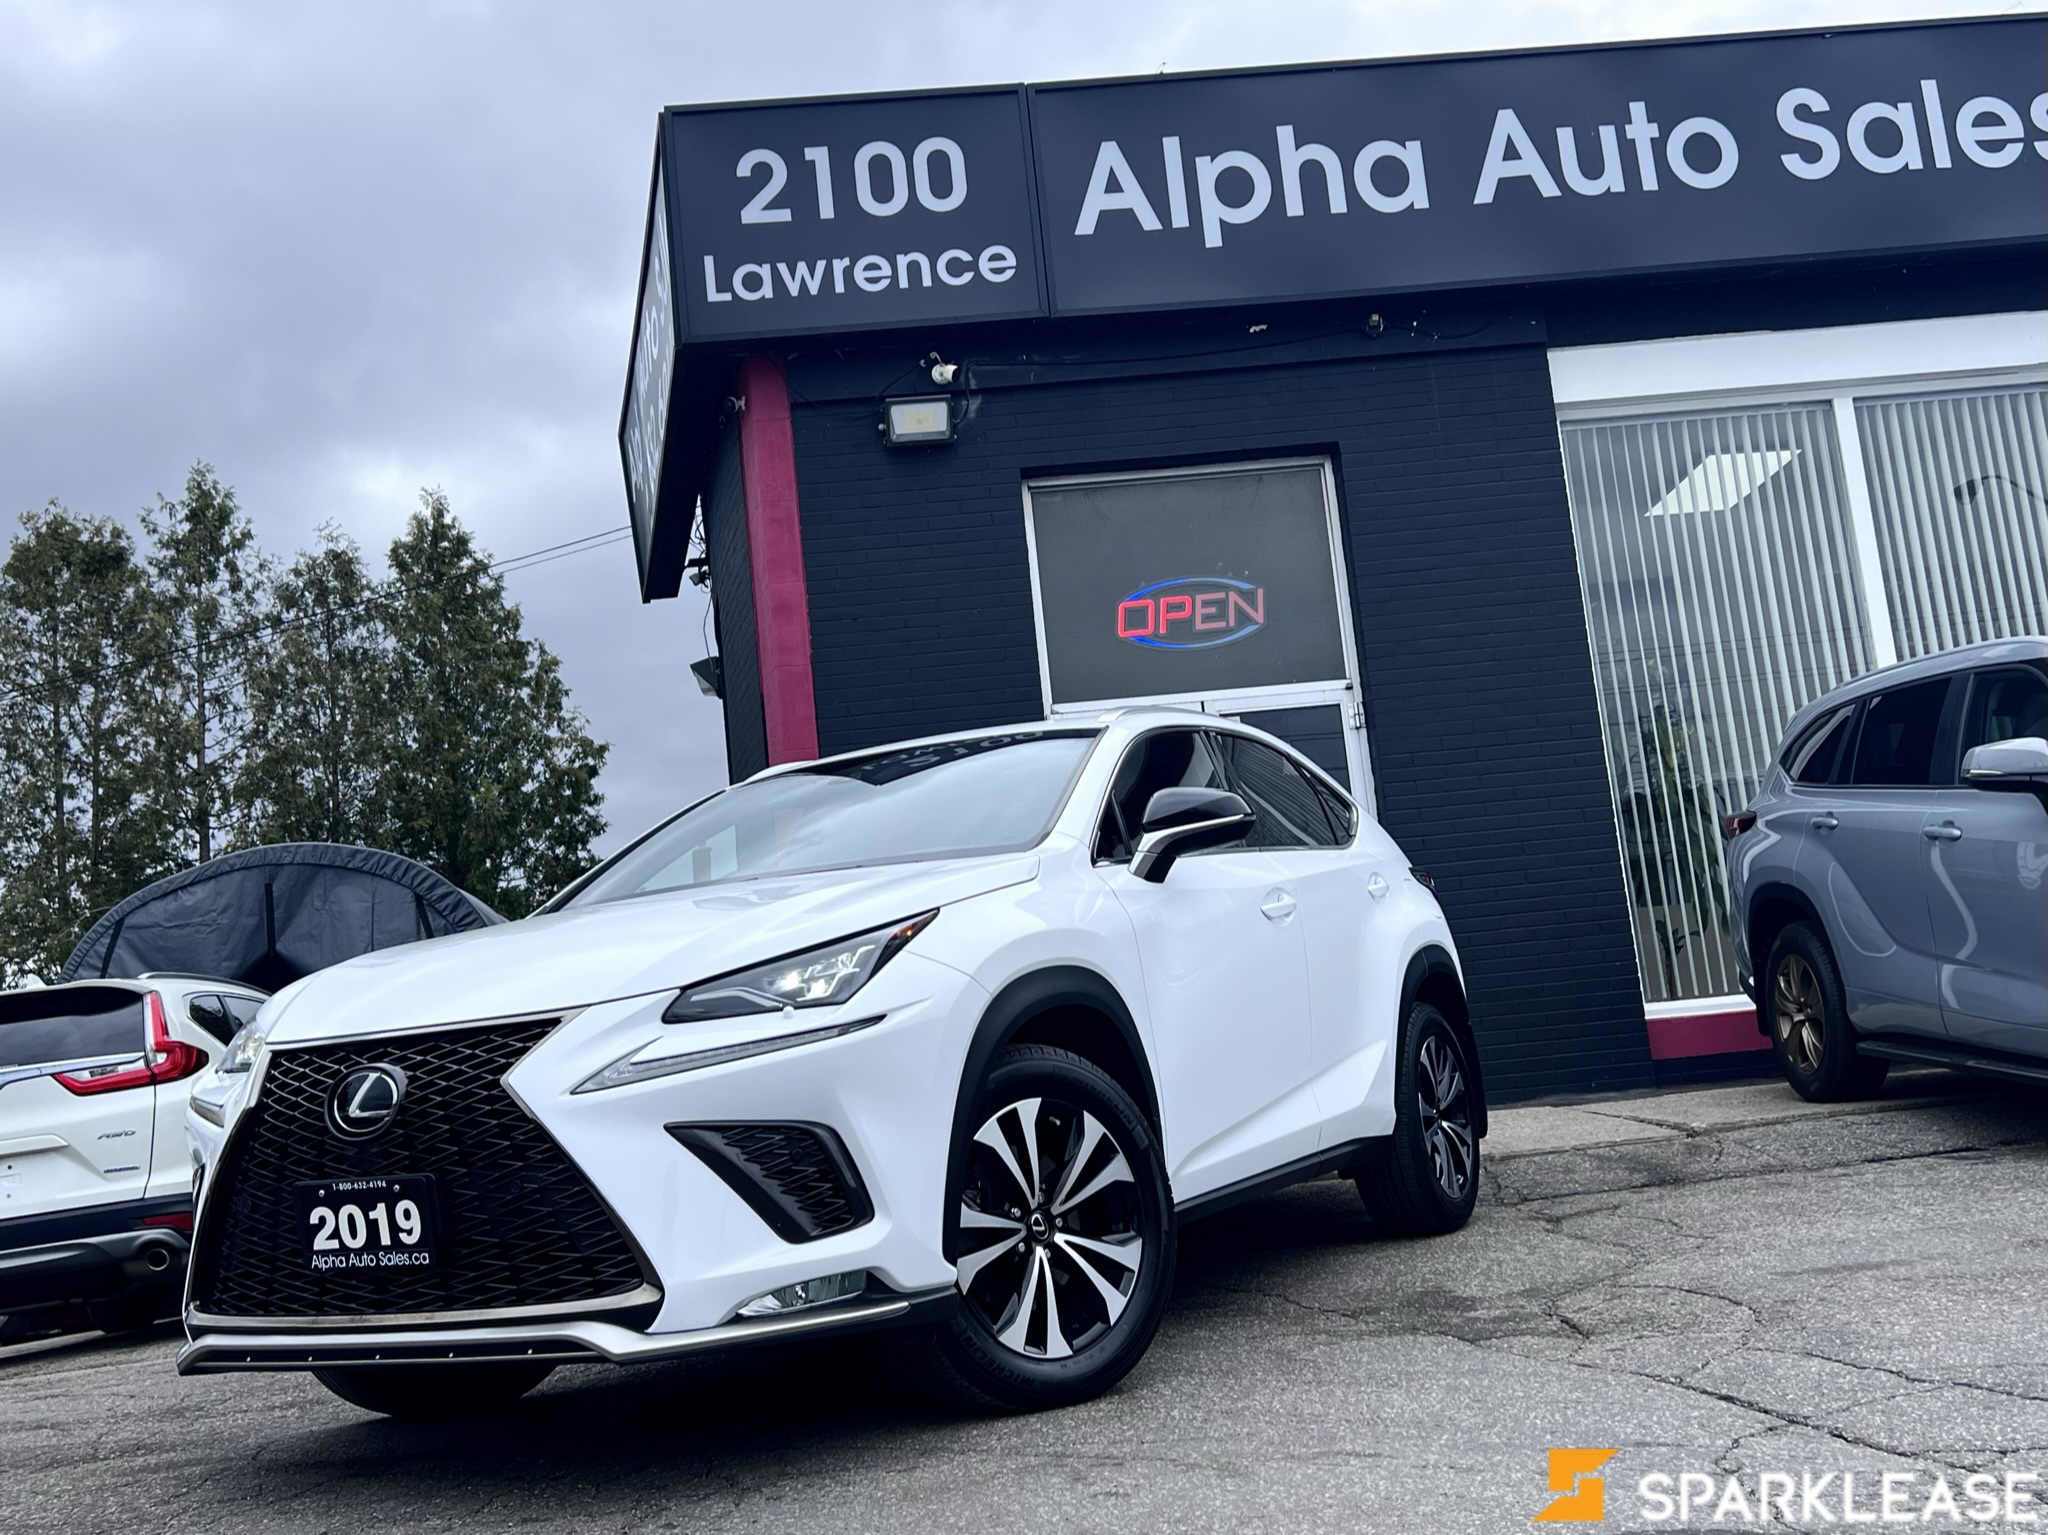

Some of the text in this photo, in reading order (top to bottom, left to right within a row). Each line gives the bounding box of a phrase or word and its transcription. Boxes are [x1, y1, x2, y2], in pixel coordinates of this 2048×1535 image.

[736, 137, 968, 225] 2100
[1074, 124, 1430, 249] Alpha
[1473, 101, 1739, 205] Auto
[703, 245, 1017, 302] Lawrence
[1117, 587, 1265, 638] OPEN
[309, 1199, 422, 1251] 2019
[311, 1250, 430, 1272] Alpha Auto Sales.ca
